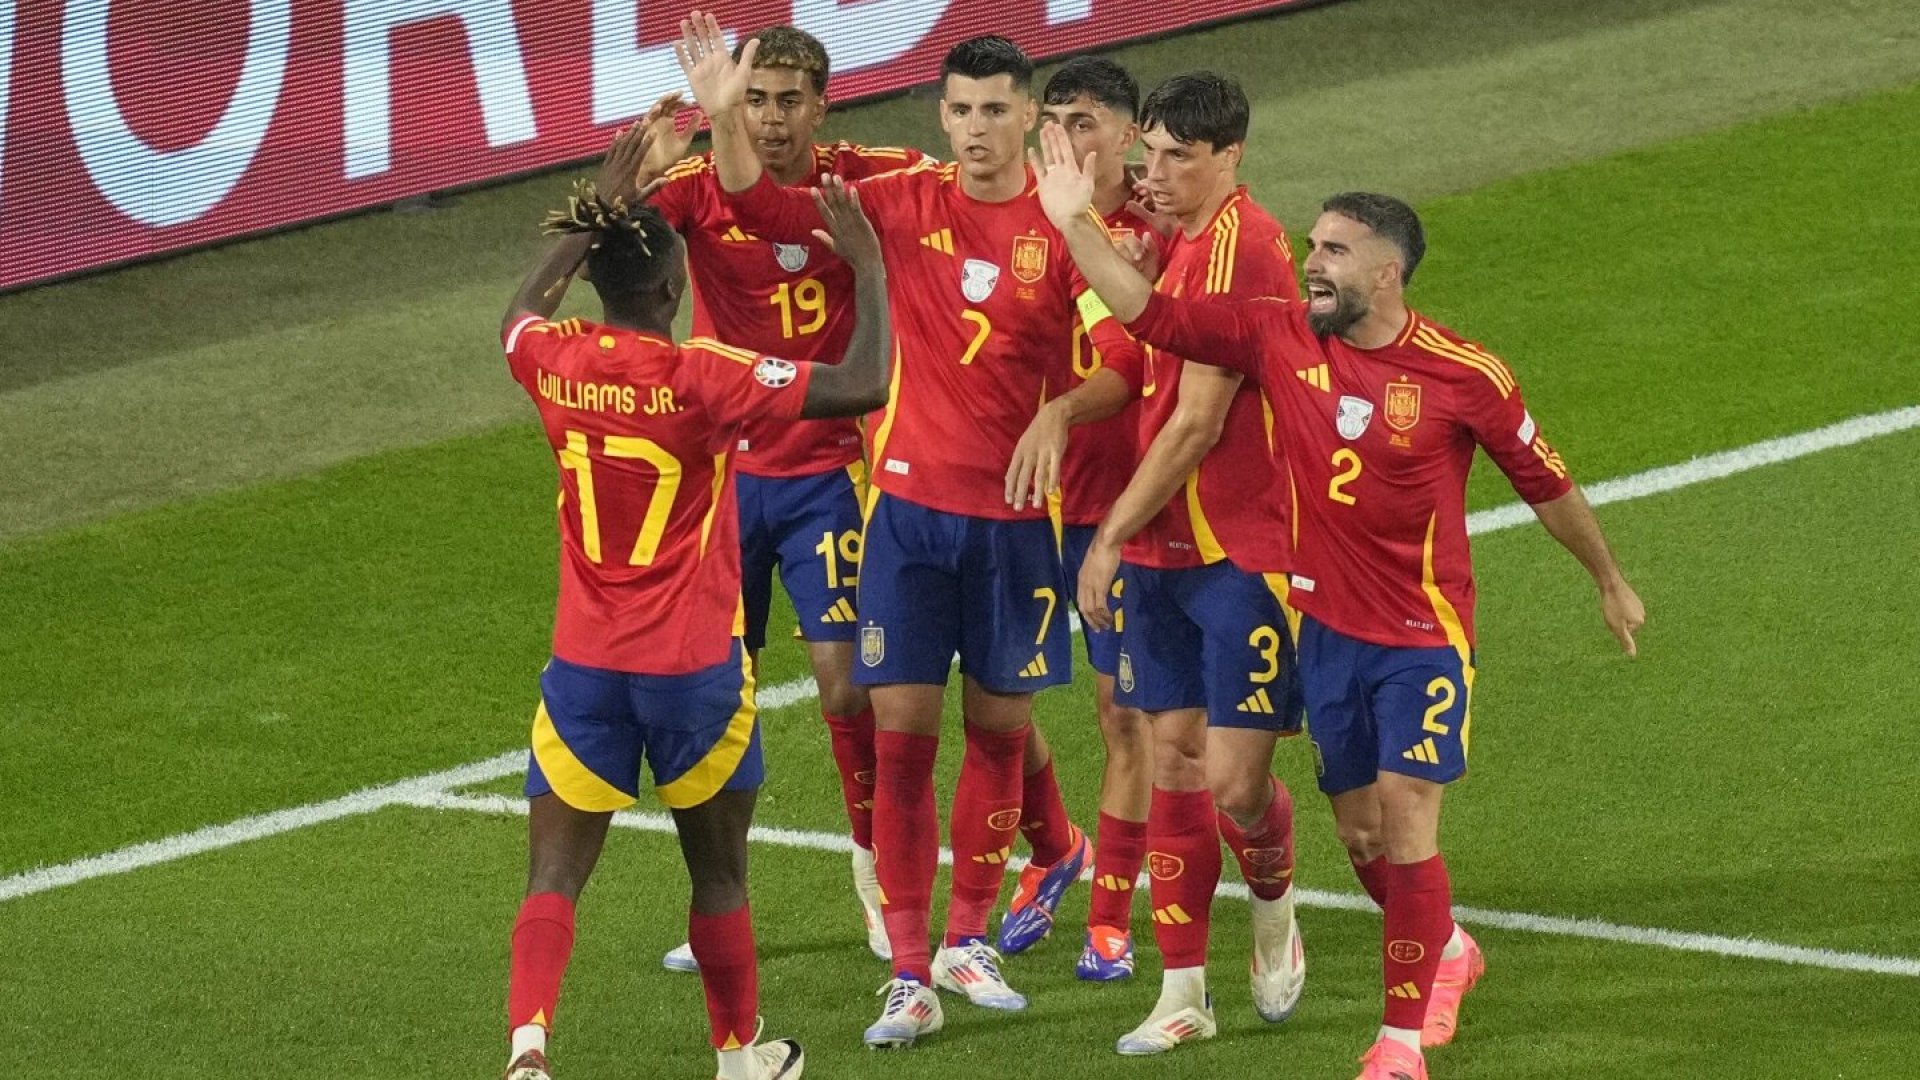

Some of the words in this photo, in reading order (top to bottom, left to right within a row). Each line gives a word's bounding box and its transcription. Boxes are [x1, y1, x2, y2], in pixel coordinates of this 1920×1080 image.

[770, 278, 827, 338] 19
[960, 308, 991, 364] 7
[537, 367, 636, 414] WILLIAMS
[643, 386, 684, 415] JR.
[559, 430, 682, 566] 17
[1328, 447, 1363, 505] 2
[815, 529, 858, 588] 19
[1033, 587, 1056, 644] 7
[1249, 625, 1280, 683] 3
[1422, 676, 1456, 735] 2
